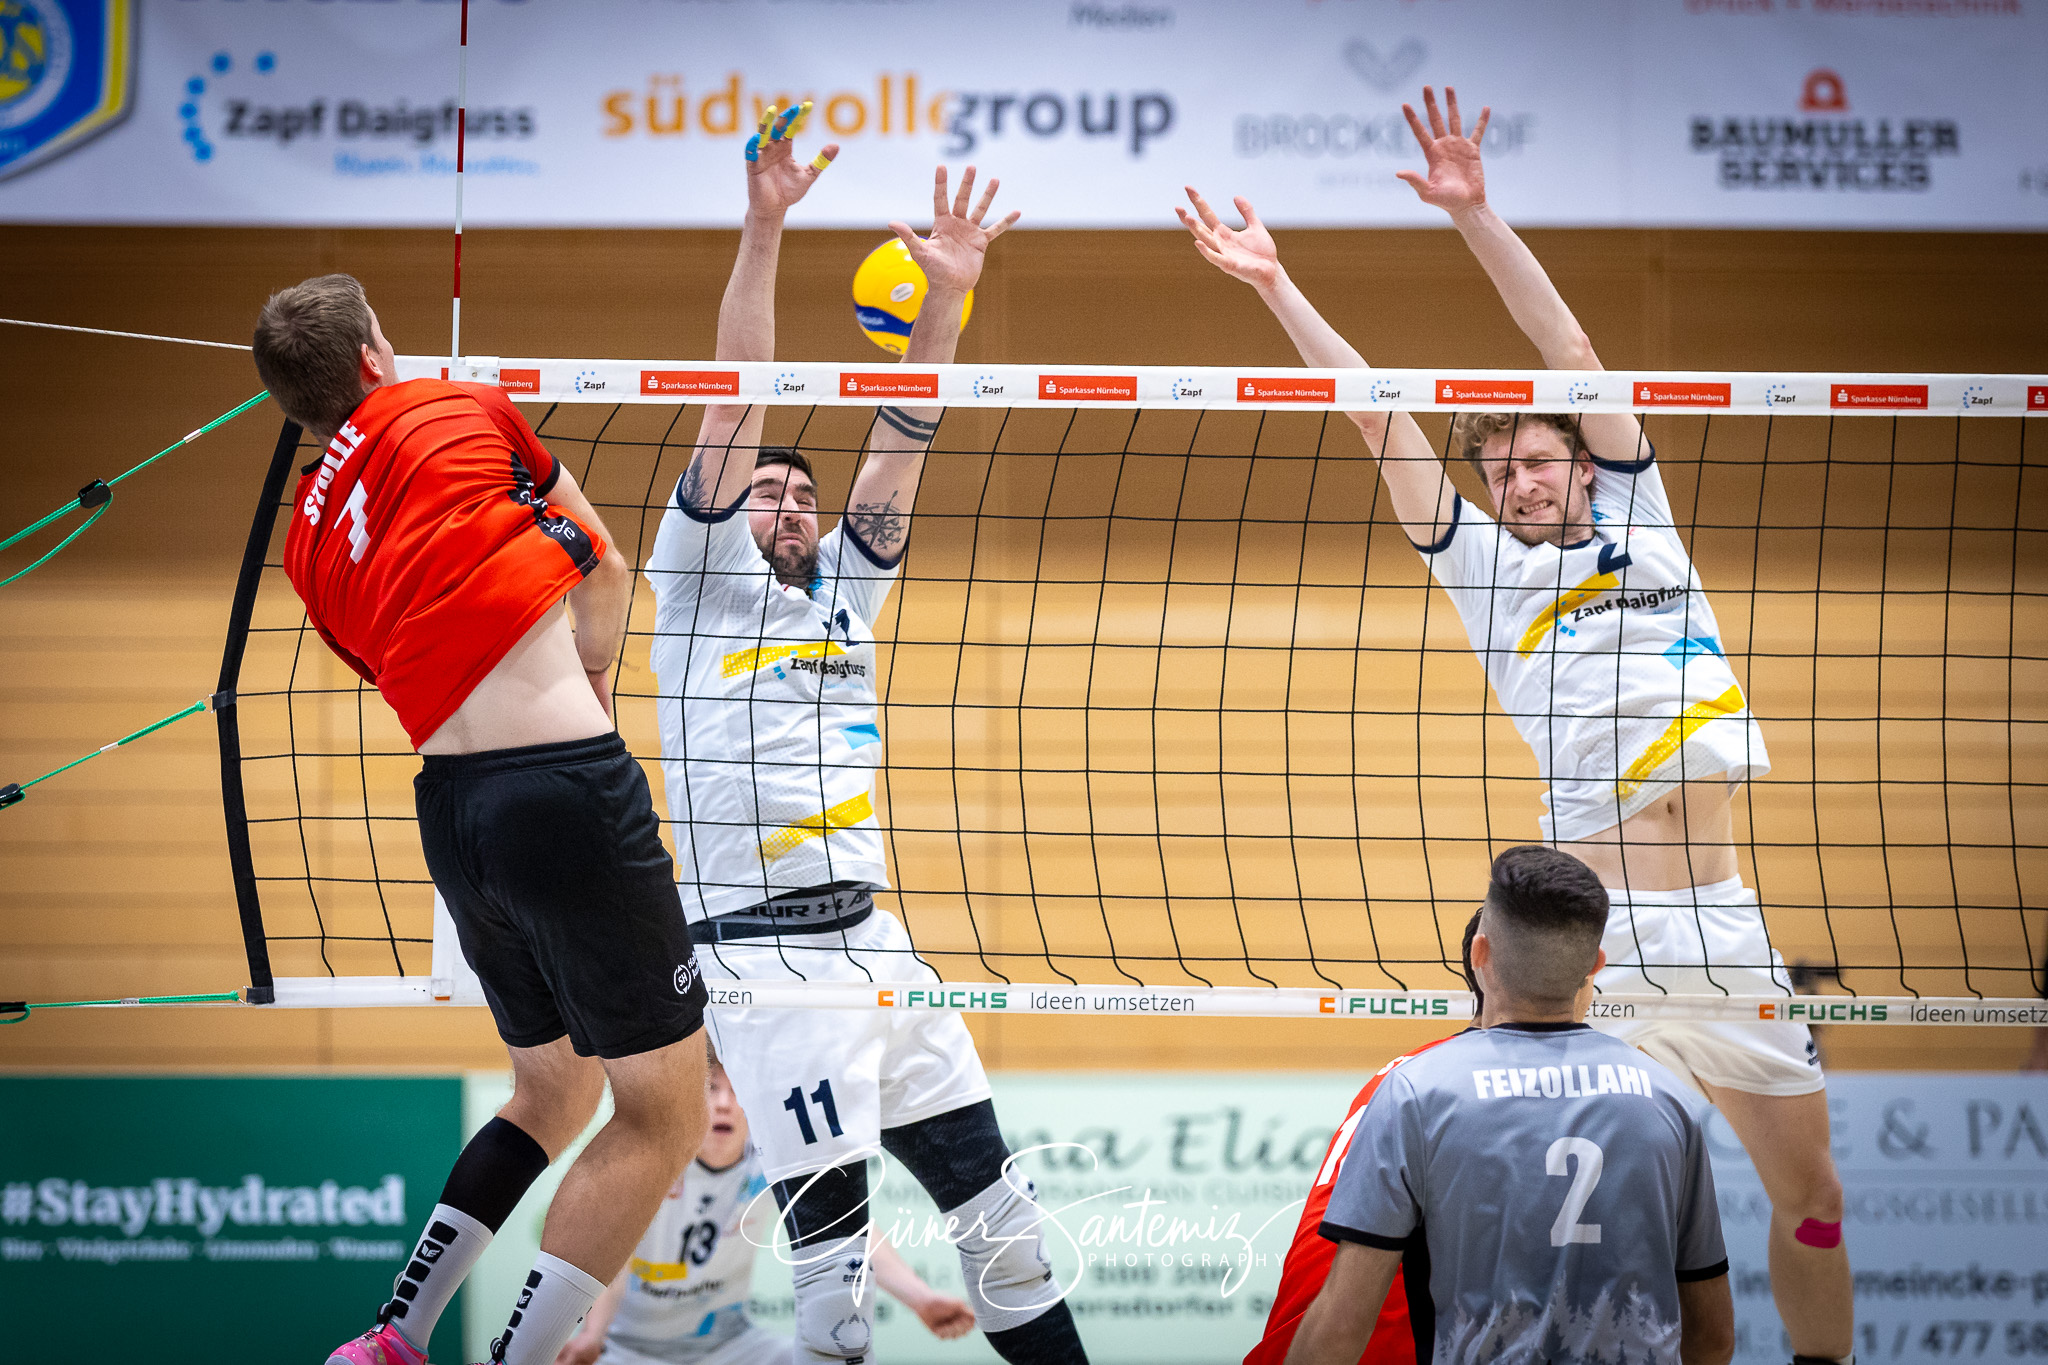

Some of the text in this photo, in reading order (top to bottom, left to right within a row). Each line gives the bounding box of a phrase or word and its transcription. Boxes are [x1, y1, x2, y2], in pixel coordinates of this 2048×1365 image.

[226, 99, 535, 146] Zapf Daigfuss
[500, 380, 532, 389] Nürnberg
[583, 381, 606, 392] Zapf
[661, 380, 732, 391] Sparkasse Nürnberg
[782, 383, 805, 394] Zapf
[860, 383, 931, 394] Sparkasse Nürnberg
[981, 386, 1004, 396] Zapf
[1059, 385, 1130, 396] Sparkasse Nürnberg
[1180, 388, 1203, 399] Zapf
[1257, 388, 1328, 399] Sparkasse Nürnberg
[1378, 390, 1401, 401] Zapf
[1455, 390, 1526, 401] Sparkasse Nürnberg
[1576, 392, 1599, 403] Zapf
[1653, 392, 1724, 403] Sparkasse Nürnberg
[1774, 394, 1797, 405] Zapf
[1851, 394, 1922, 405] Sparkasse Nürnberg
[1971, 396, 1994, 407] Zapf
[908, 991, 1195, 1012] FUCHS Ideen umsetzen
[1349, 997, 1449, 1016] FUCHS
[1789, 1003, 1888, 1021] FUCHS
[1910, 1003, 1966, 1023] Ideen
[1472, 1063, 1653, 1099] FEIZOLLAHI
[783, 1078, 845, 1146] 11
[1545, 1136, 1604, 1248] 2
[2, 1174, 406, 1237] #StayHydrated
[678, 1220, 718, 1266] 13
